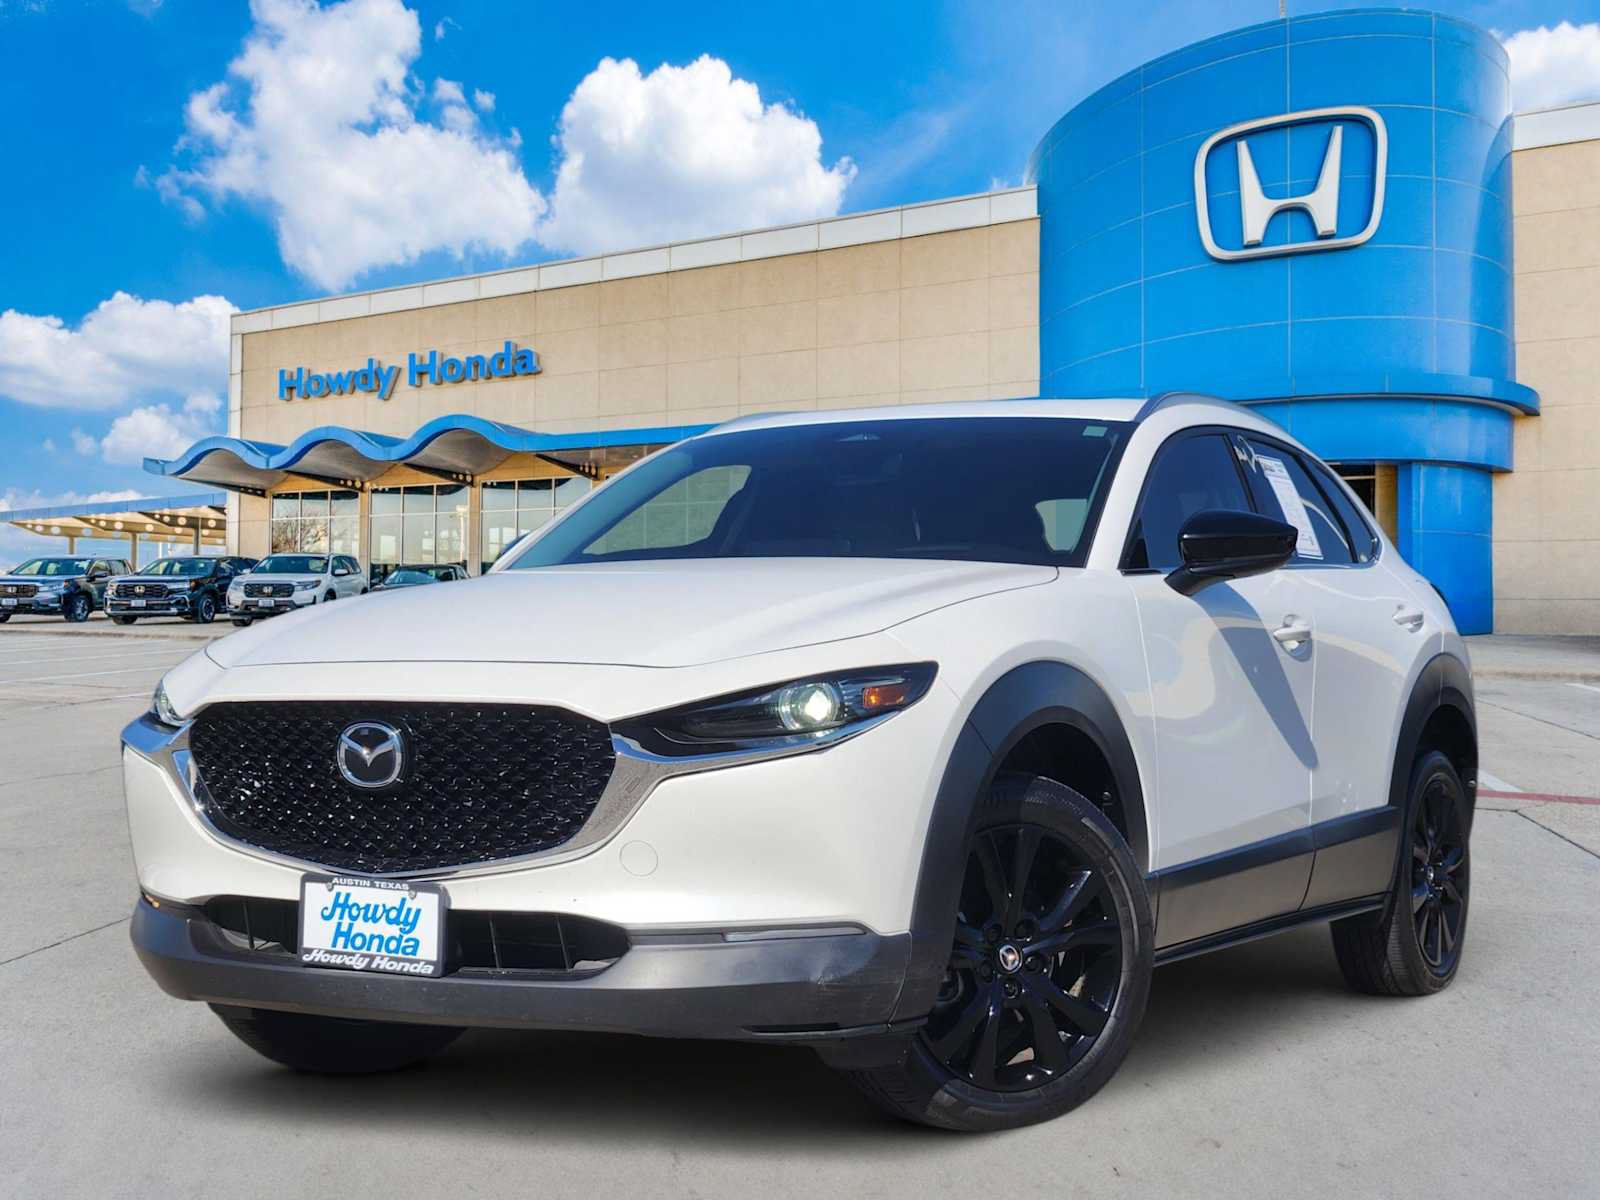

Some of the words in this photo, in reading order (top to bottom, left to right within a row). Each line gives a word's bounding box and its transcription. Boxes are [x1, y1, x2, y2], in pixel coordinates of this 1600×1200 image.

[278, 357, 400, 401] Howdy
[408, 340, 541, 387] Honda
[332, 877, 370, 887] AUSTIN
[374, 880, 410, 891] TEXAS
[320, 891, 421, 935] Howdy
[331, 922, 420, 956] Honda
[302, 949, 370, 970] Howdy
[371, 955, 434, 975] Honda
